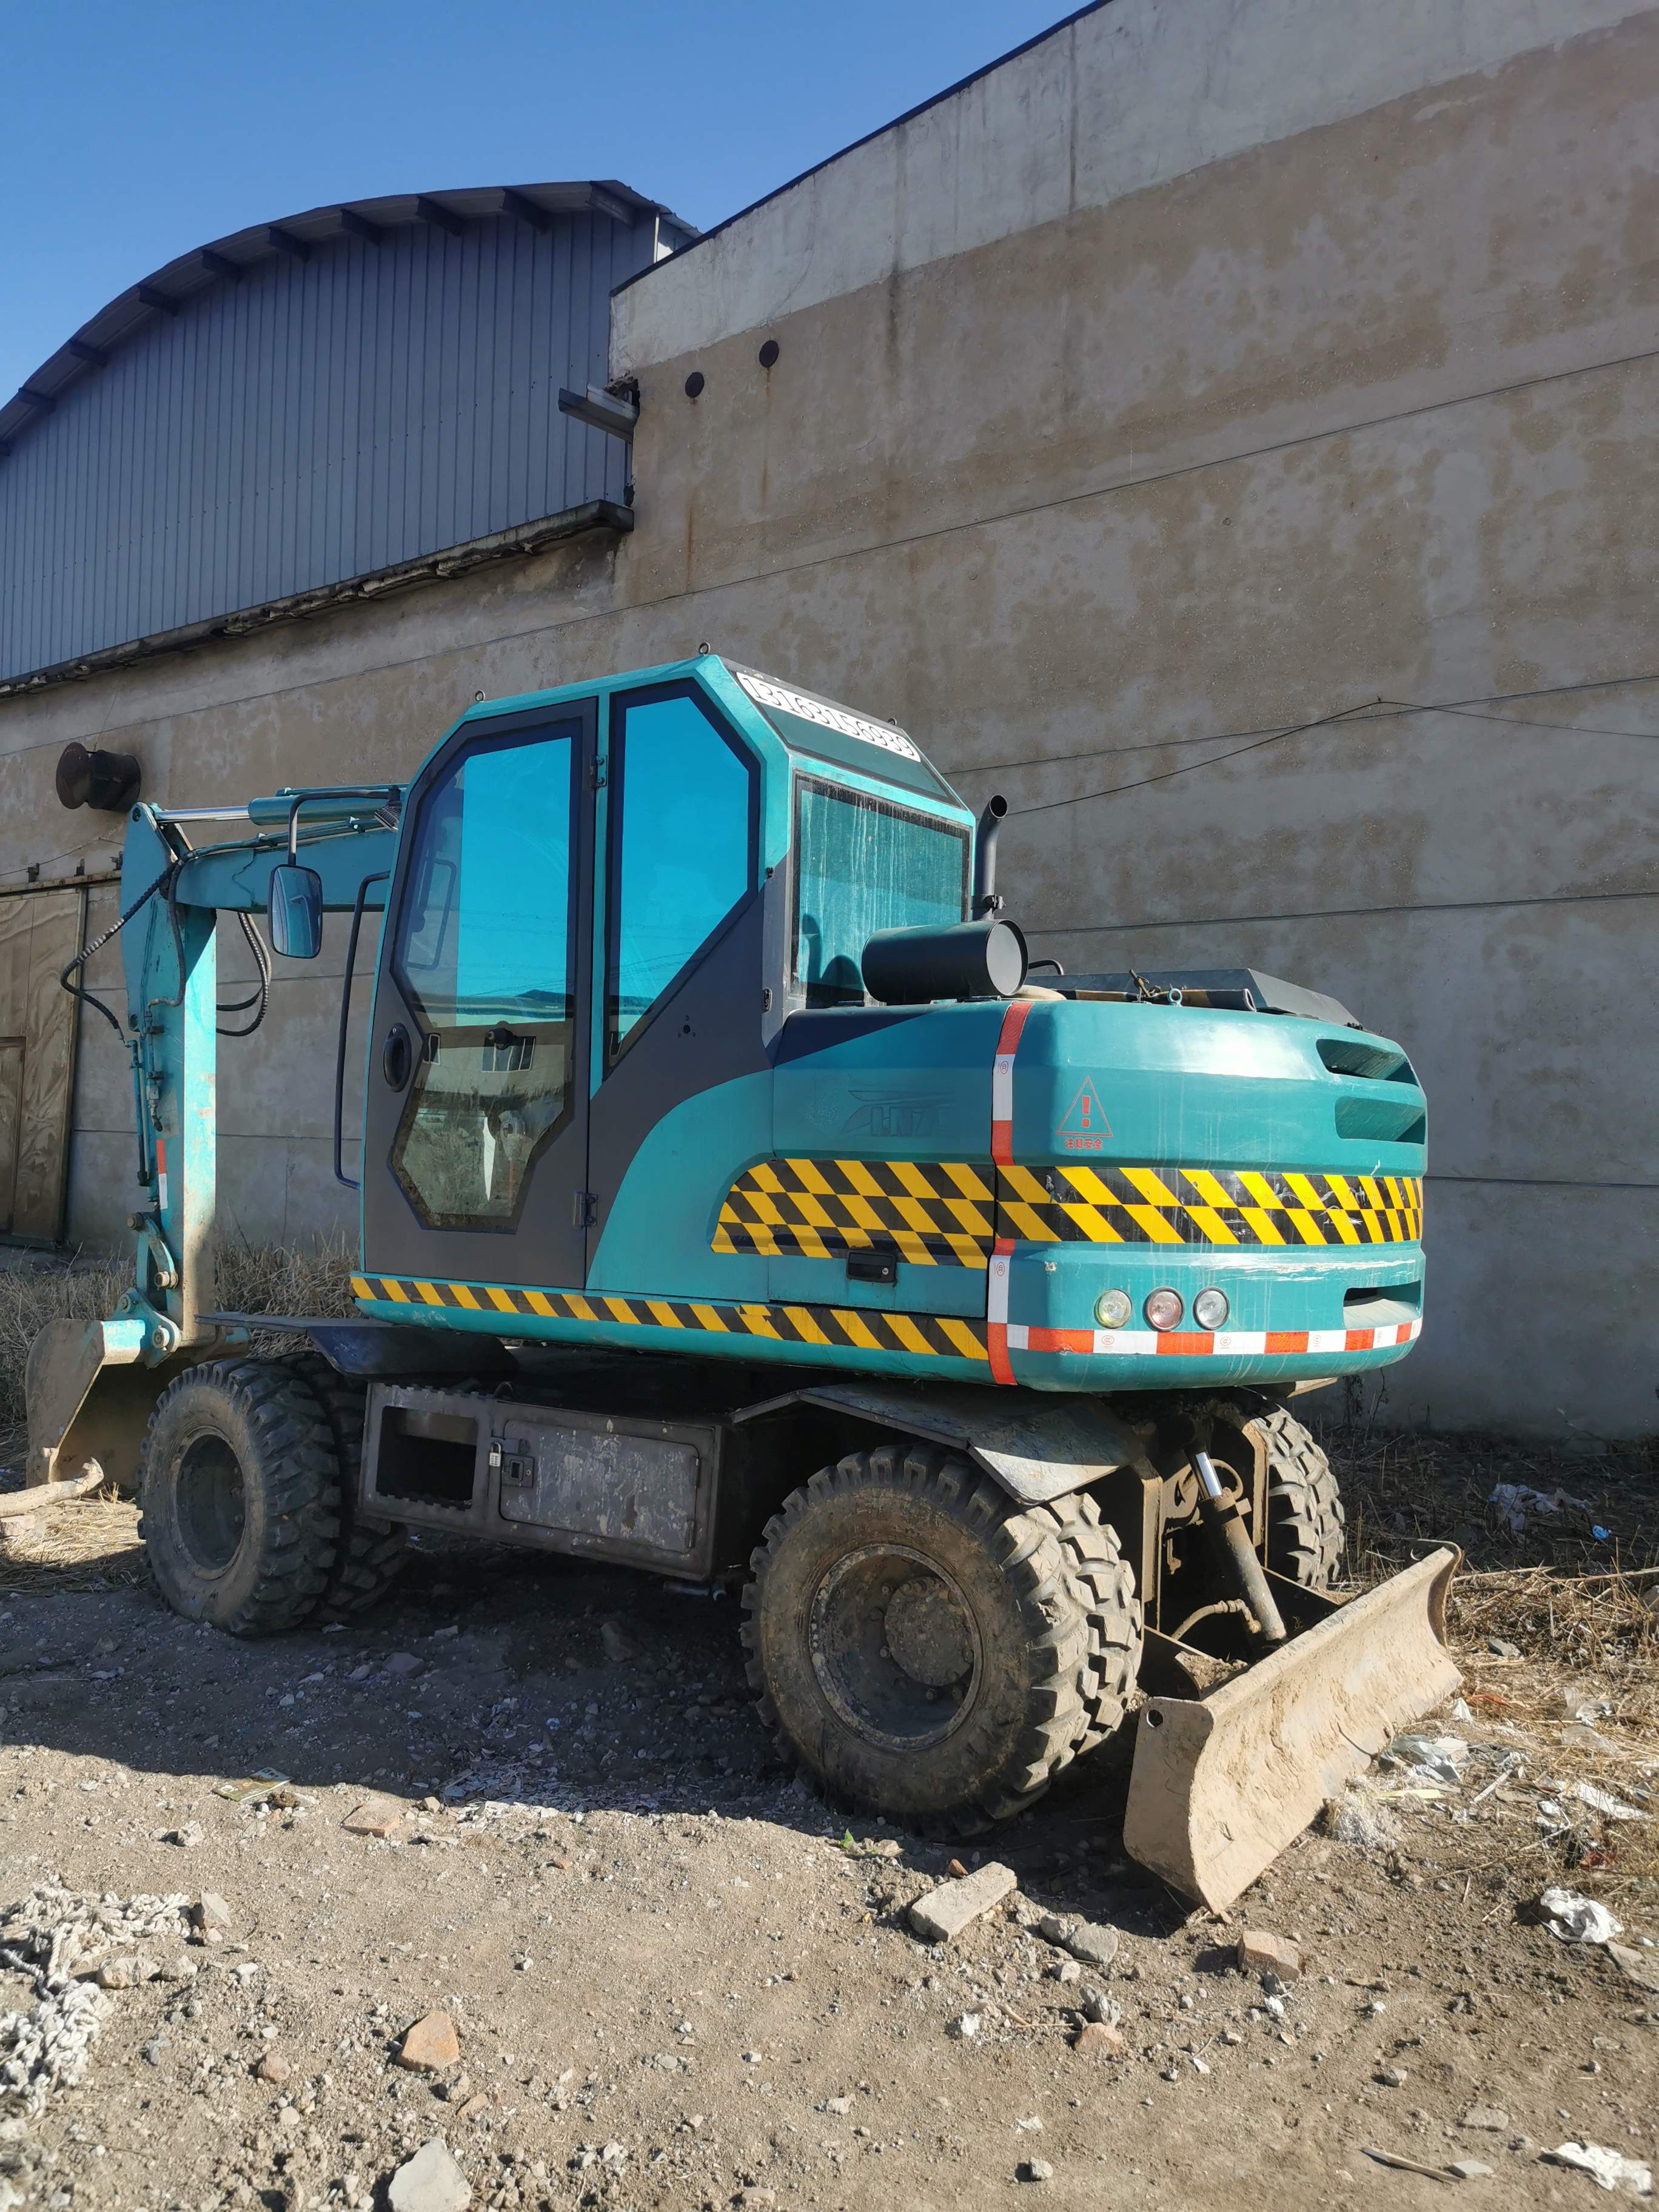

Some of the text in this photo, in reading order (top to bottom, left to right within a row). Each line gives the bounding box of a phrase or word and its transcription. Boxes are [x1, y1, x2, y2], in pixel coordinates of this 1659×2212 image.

[742, 677, 915, 757] 13163156939
[1065, 1138, 1102, 1150] 注意安全
